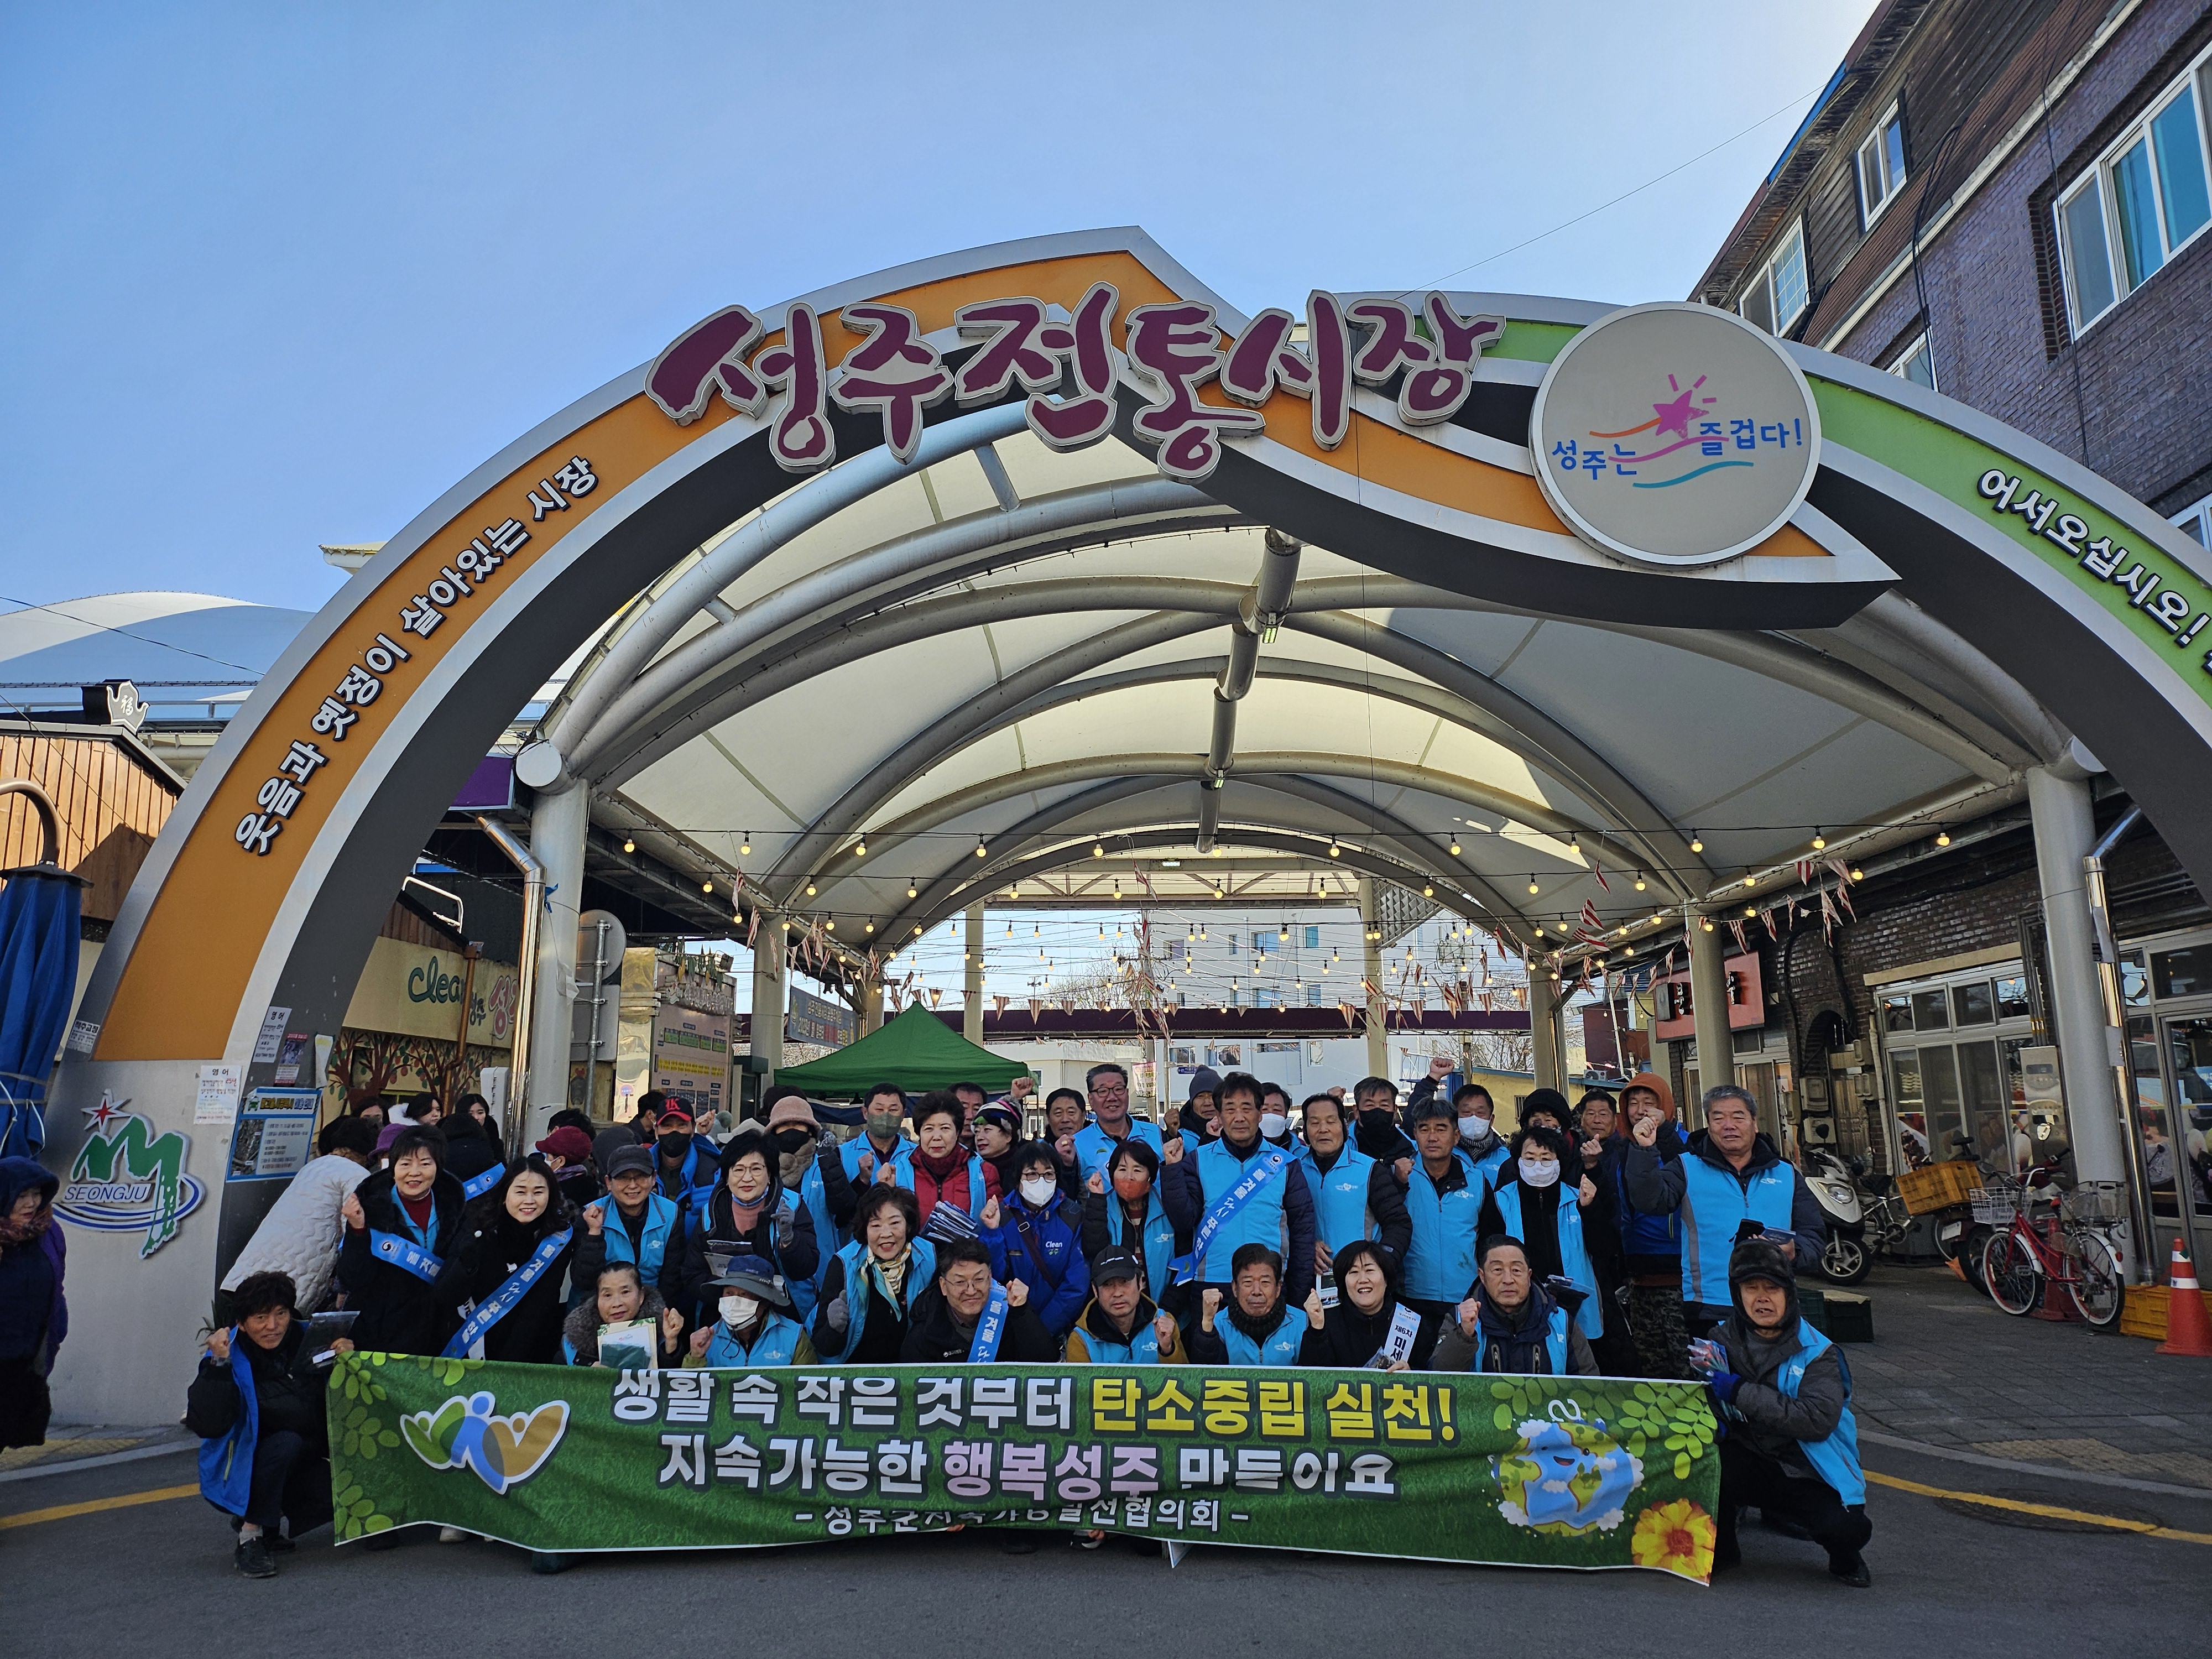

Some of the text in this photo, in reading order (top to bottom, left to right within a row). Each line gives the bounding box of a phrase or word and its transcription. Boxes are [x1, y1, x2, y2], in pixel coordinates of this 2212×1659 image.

[644, 281, 1506, 485] 성주전통시장
[1552, 418, 1802, 480] 성주는 즐겁다!
[1977, 469, 2211, 648] 어서오십시오!
[235, 455, 599, 856] 웃음과 옛정이 살아있는 시장
[121, 695, 134, 716] 福
[65, 1185, 149, 1201] SEONGJU
[977, 1345, 990, 1363] 다
[1394, 1324, 1413, 1338] 제6차
[613, 1368, 1455, 1441] 생활 속 작은 것부터 탄소중립 실천!
[659, 1433, 928, 1494] 지속가능한
[943, 1441, 1160, 1502] 행복성주
